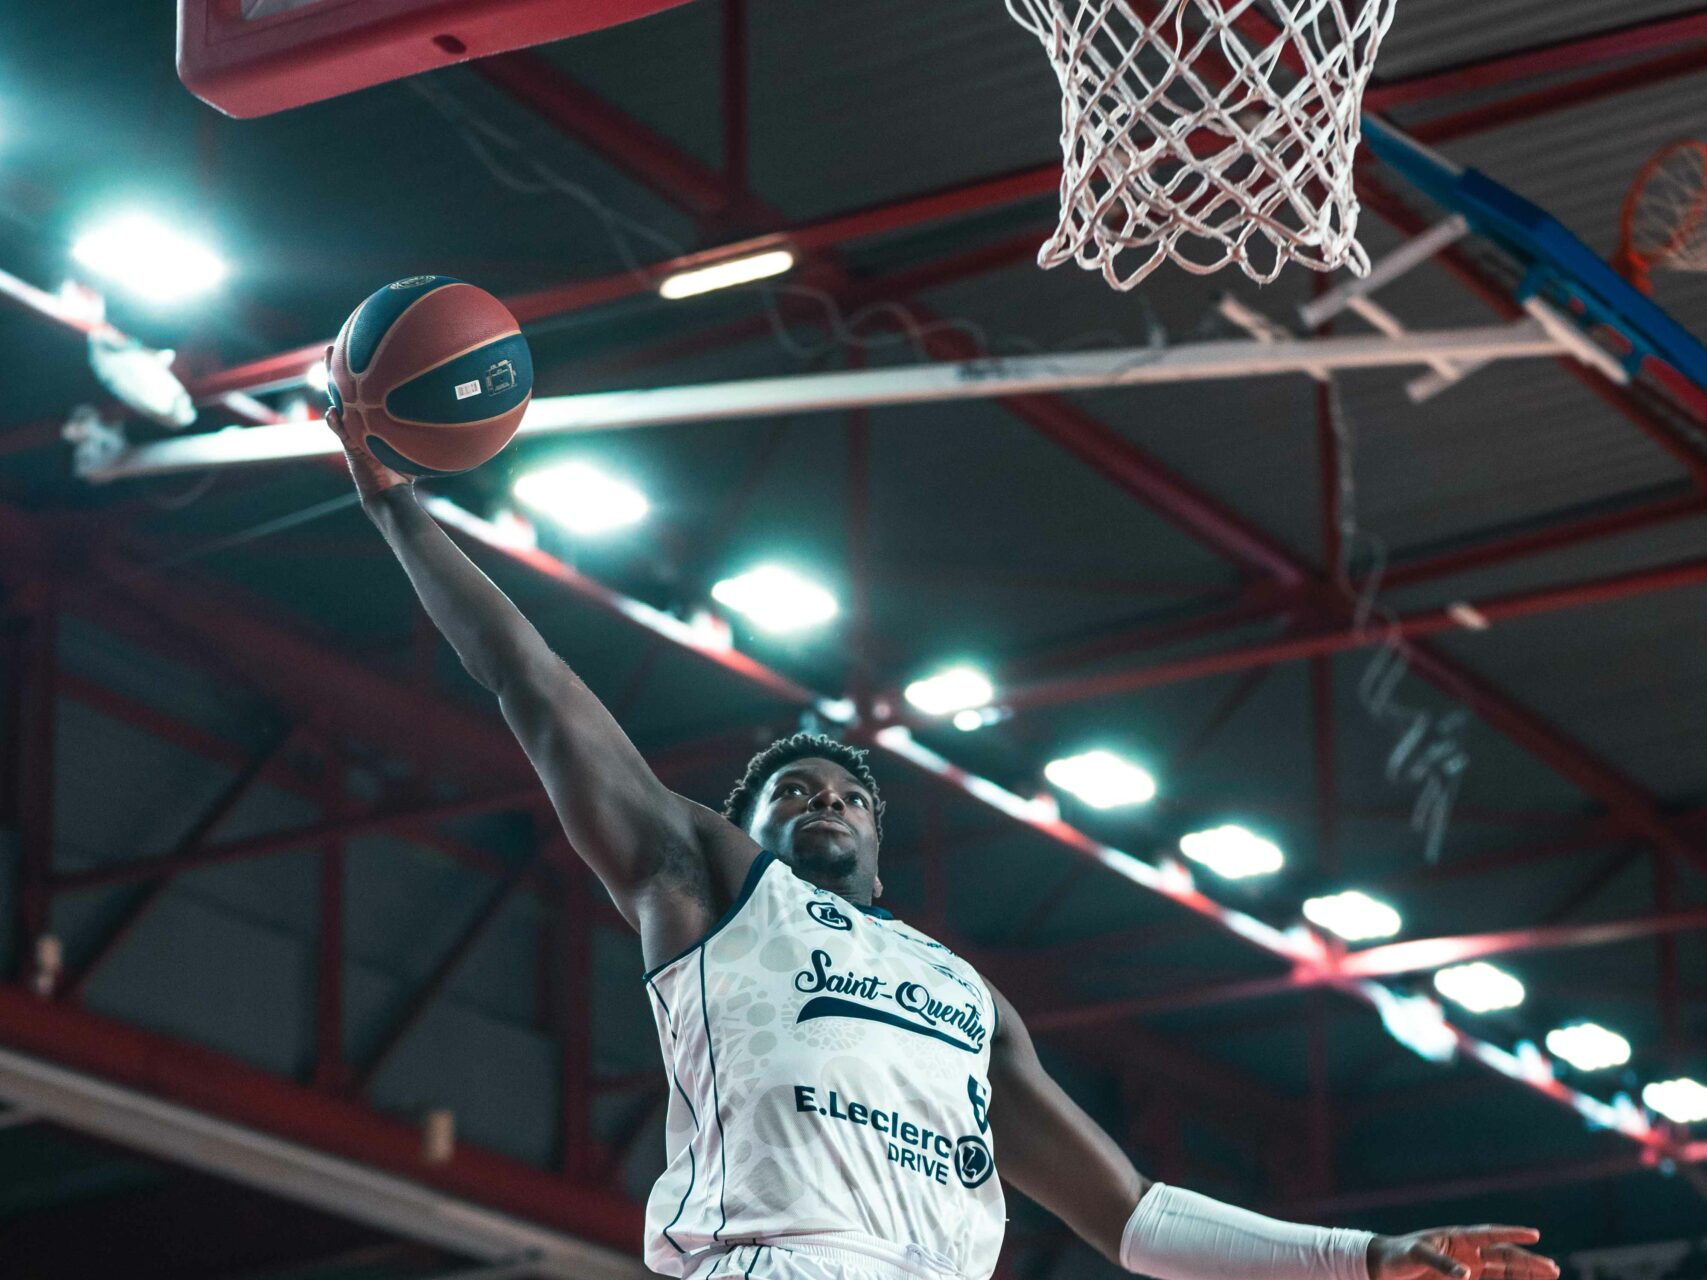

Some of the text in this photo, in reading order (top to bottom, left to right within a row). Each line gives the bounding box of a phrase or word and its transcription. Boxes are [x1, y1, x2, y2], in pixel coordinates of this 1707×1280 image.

[795, 950, 986, 1046] Saint-Quentin
[794, 1085, 953, 1159] E.Leclerc
[887, 1142, 950, 1186] DRIVE
